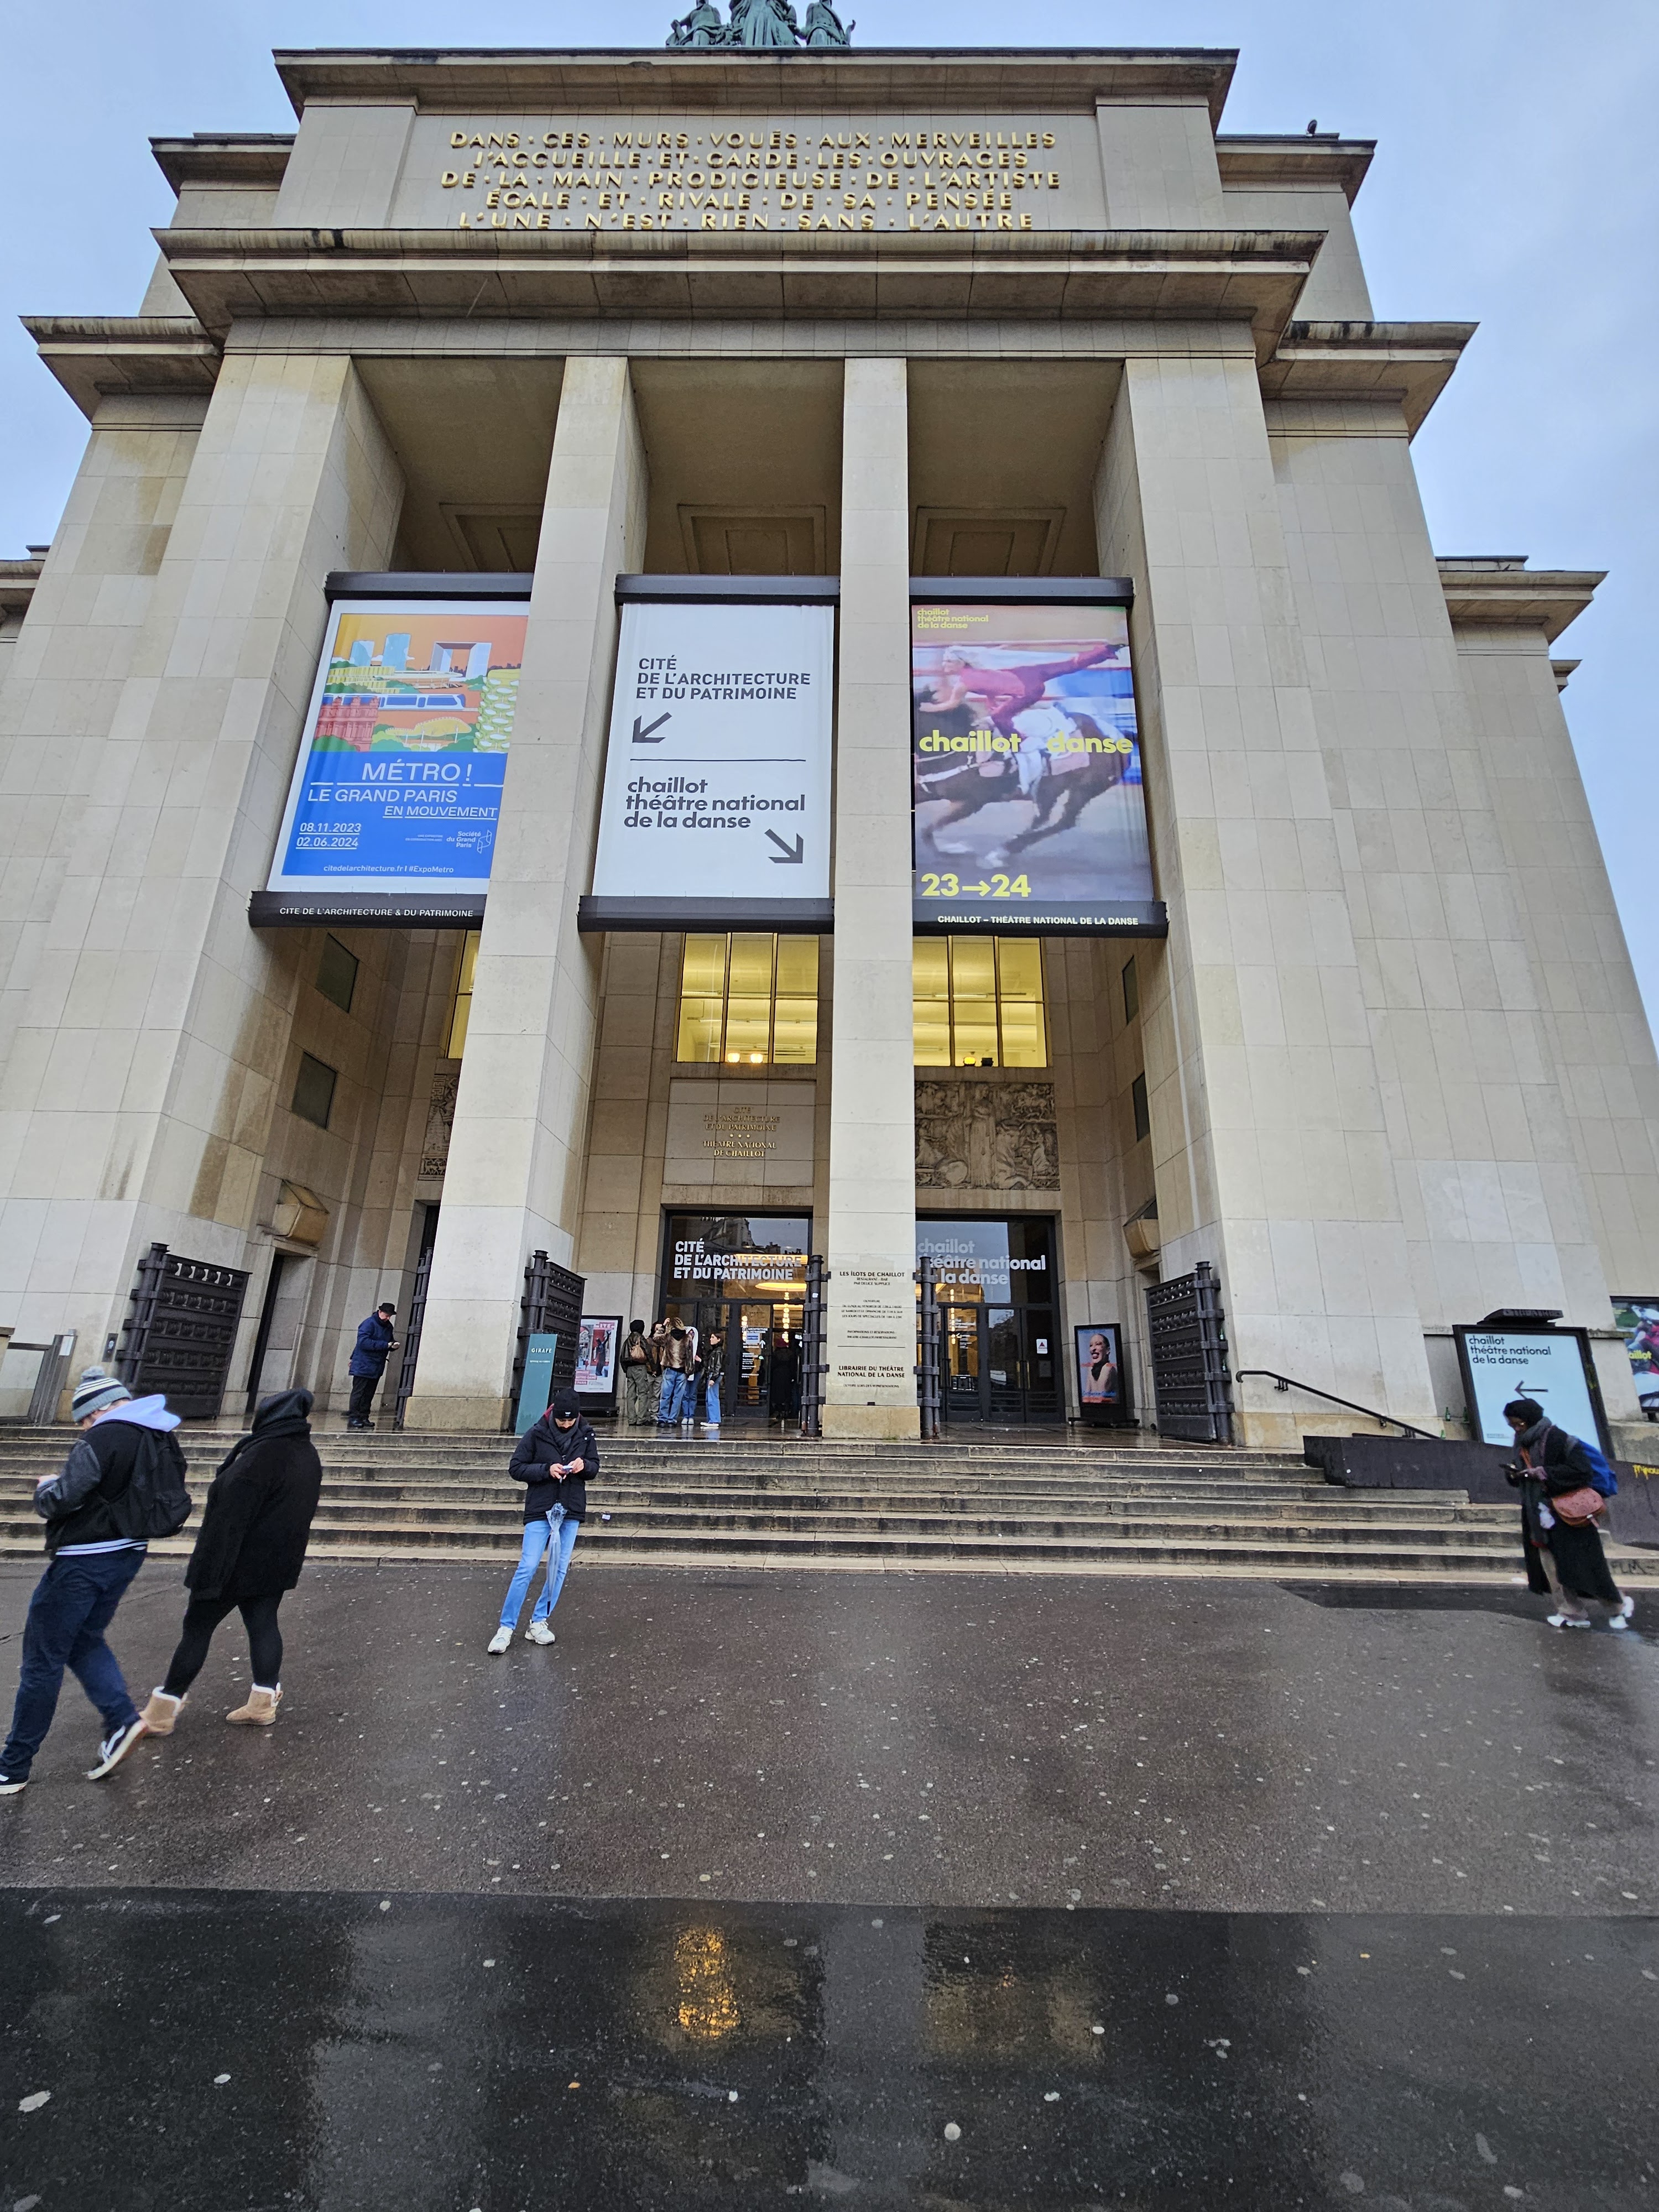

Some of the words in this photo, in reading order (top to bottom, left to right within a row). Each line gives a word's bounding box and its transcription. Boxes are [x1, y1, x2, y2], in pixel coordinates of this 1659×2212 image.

[450, 132, 520, 148] DANS
[542, 132, 590, 148] CES
[612, 132, 690, 149] MURS
[710, 129, 797, 149] VOUÉS
[820, 132, 871, 149] AUX
[891, 132, 1056, 149] MERVEILLES
[473, 151, 641, 168] J'ACCUEILLE
[659, 152, 690, 168] ET
[706, 152, 797, 168] GARDE
[817, 152, 862, 168] LES
[880, 152, 1028, 168] OUVRAGES
[441, 171, 476, 189] DE
[498, 171, 529, 189] LA
[552, 171, 623, 189] MAIN
[648, 171, 842, 189] PRODIGIEUSE
[866, 171, 900, 189] DE
[925, 171, 1060, 189] L'ARTISTE
[485, 188, 571, 209] ÉGALE
[598, 191, 630, 209] ET
[658, 192, 752, 210] RIVALE
[780, 192, 814, 210] DE
[843, 192, 877, 210] SA
[906, 189, 1013, 210] PENSÉE
[459, 212, 551, 229] L'UNE
[585, 212, 672, 229] N'EST
[700, 212, 769, 229] RIEN
[797, 213, 875, 230] SANS
[909, 213, 1033, 230] L'AUTRE
[639, 655, 677, 670] CITÉ
[638, 672, 660, 685] DE
[665, 672, 811, 685] L'ARCHITECTURE
[636, 687, 658, 699] ET
[662, 687, 686, 700] DU
[690, 687, 797, 700] PATRIMOINE
[919, 729, 1022, 753] chaillot
[1046, 731, 1134, 754] danse
[361, 759, 461, 782] MÉTRO
[628, 776, 708, 794] chaillot
[307, 789, 331, 802] LE
[335, 789, 400, 803] GRAND
[403, 789, 458, 804] PARIS
[626, 794, 708, 811] théâtre
[712, 794, 806, 812] national
[384, 806, 404, 816] EN
[406, 806, 498, 818] MOUVEMENT
[624, 811, 653, 828] de
[657, 811, 677, 828] la
[682, 811, 751, 828] danse
[299, 822, 362, 833] 08.11.2023
[296, 837, 358, 848] 02.06.2024
[324, 864, 403, 873] citedelarchitecture.fr
[409, 865, 454, 874] #ExpoMetro
[990, 915, 1031, 924] THÉÂTRE
[716, 1115, 781, 1123] L'ARCHITECTURE
[675, 1238, 705, 1253] CITÉ
[917, 1238, 975, 1254] chaillot
[674, 1254, 692, 1266] DE
[694, 1254, 802, 1267] L'ARCHITECTURE
[979, 1254, 1046, 1270] national
[674, 1267, 691, 1279] ET
[692, 1267, 711, 1280] DU
[713, 1268, 794, 1280] PATRIMOINE
[941, 1268, 956, 1284] la
[958, 1268, 1009, 1285] danse
[1469, 1335, 1505, 1345] chaillot
[1470, 1345, 1508, 1355] théâtre
[1510, 1347, 1552, 1355] national
[1473, 1355, 1485, 1364] de
[1487, 1355, 1497, 1364] la
[1498, 1356, 1529, 1364] danse
